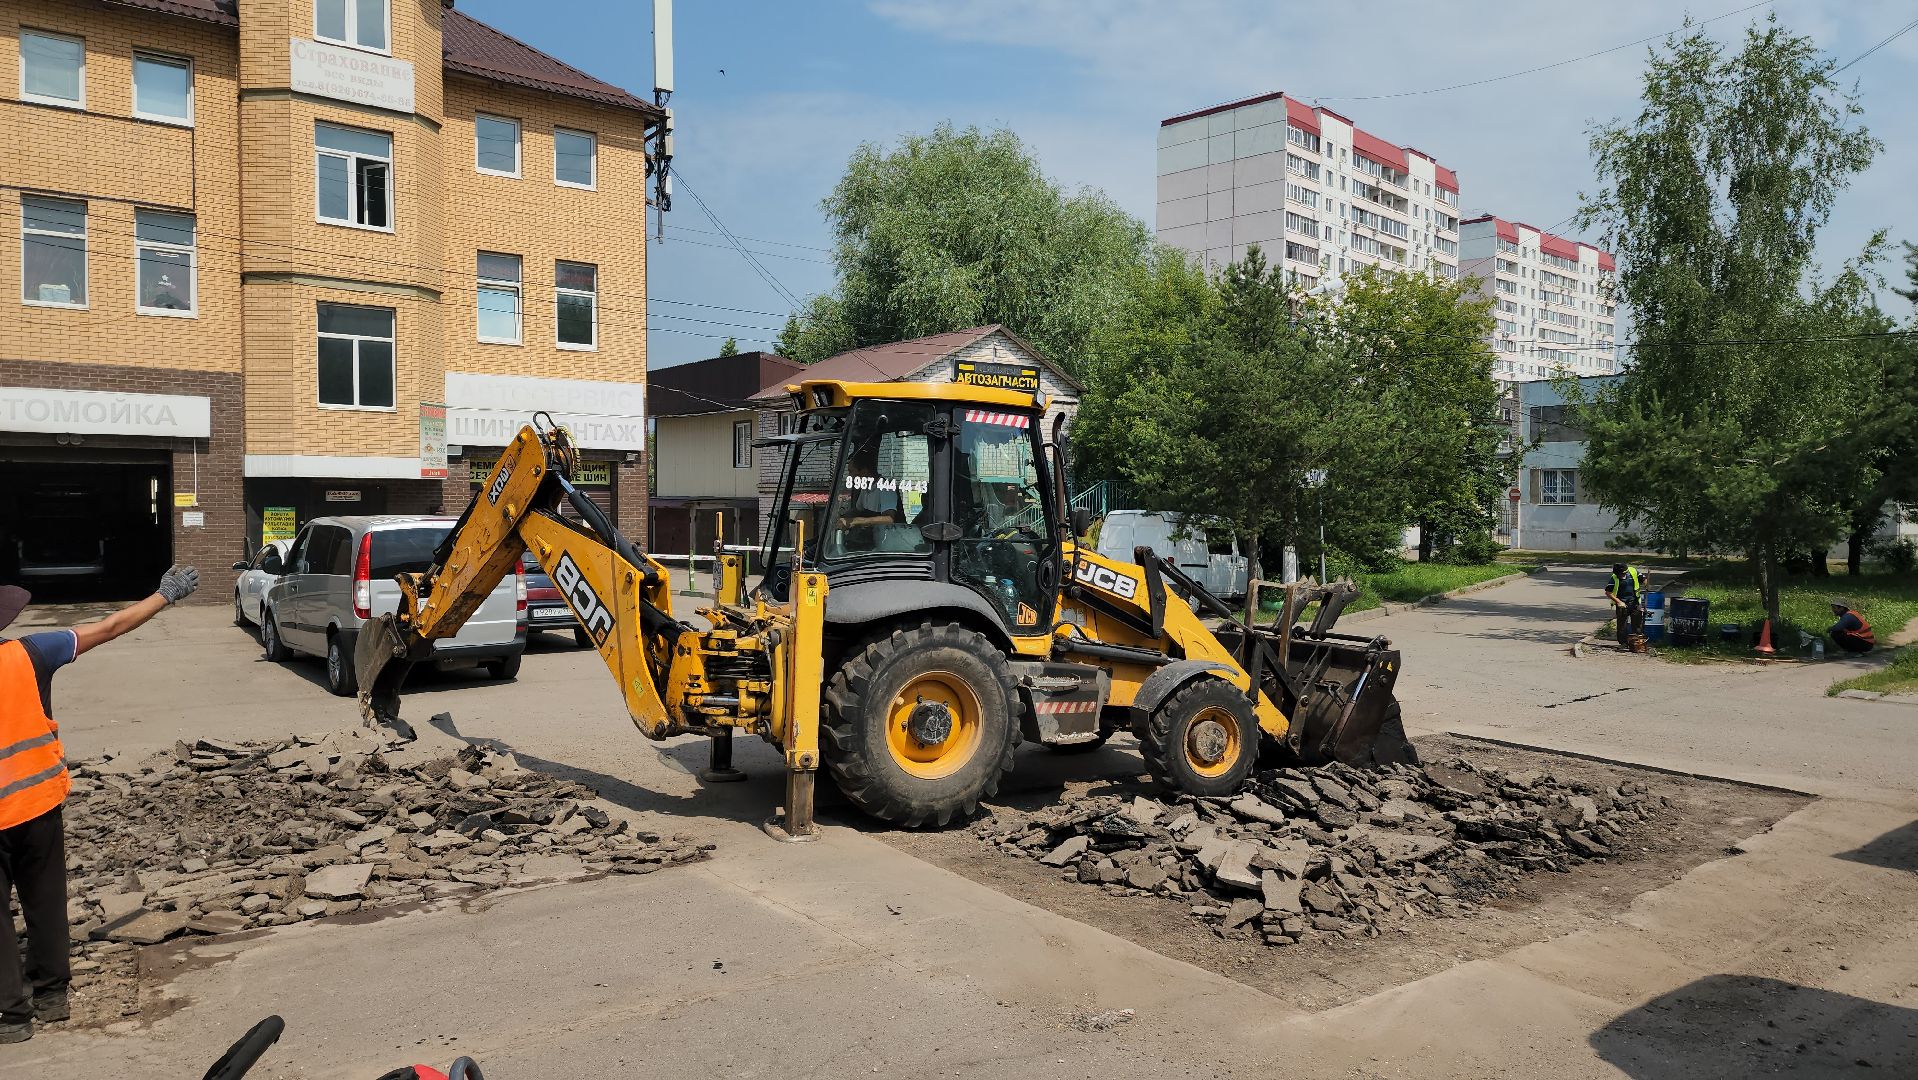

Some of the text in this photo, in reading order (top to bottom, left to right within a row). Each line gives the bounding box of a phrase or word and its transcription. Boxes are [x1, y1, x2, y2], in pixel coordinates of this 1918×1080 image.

[294, 42, 410, 80] Страхование
[956, 372, 1038, 389] АВТОЗАПЧАСТИ
[0, 398, 178, 426] ТОМОЙКА
[455, 417, 637, 442] ШИННТАЖ
[583, 473, 607, 482] ШИН
[853, 476, 875, 491] 987
[876, 477, 897, 492] 444
[555, 555, 612, 632] JCB
[1076, 563, 1137, 599] JCB
[1018, 604, 1037, 624] JCB
